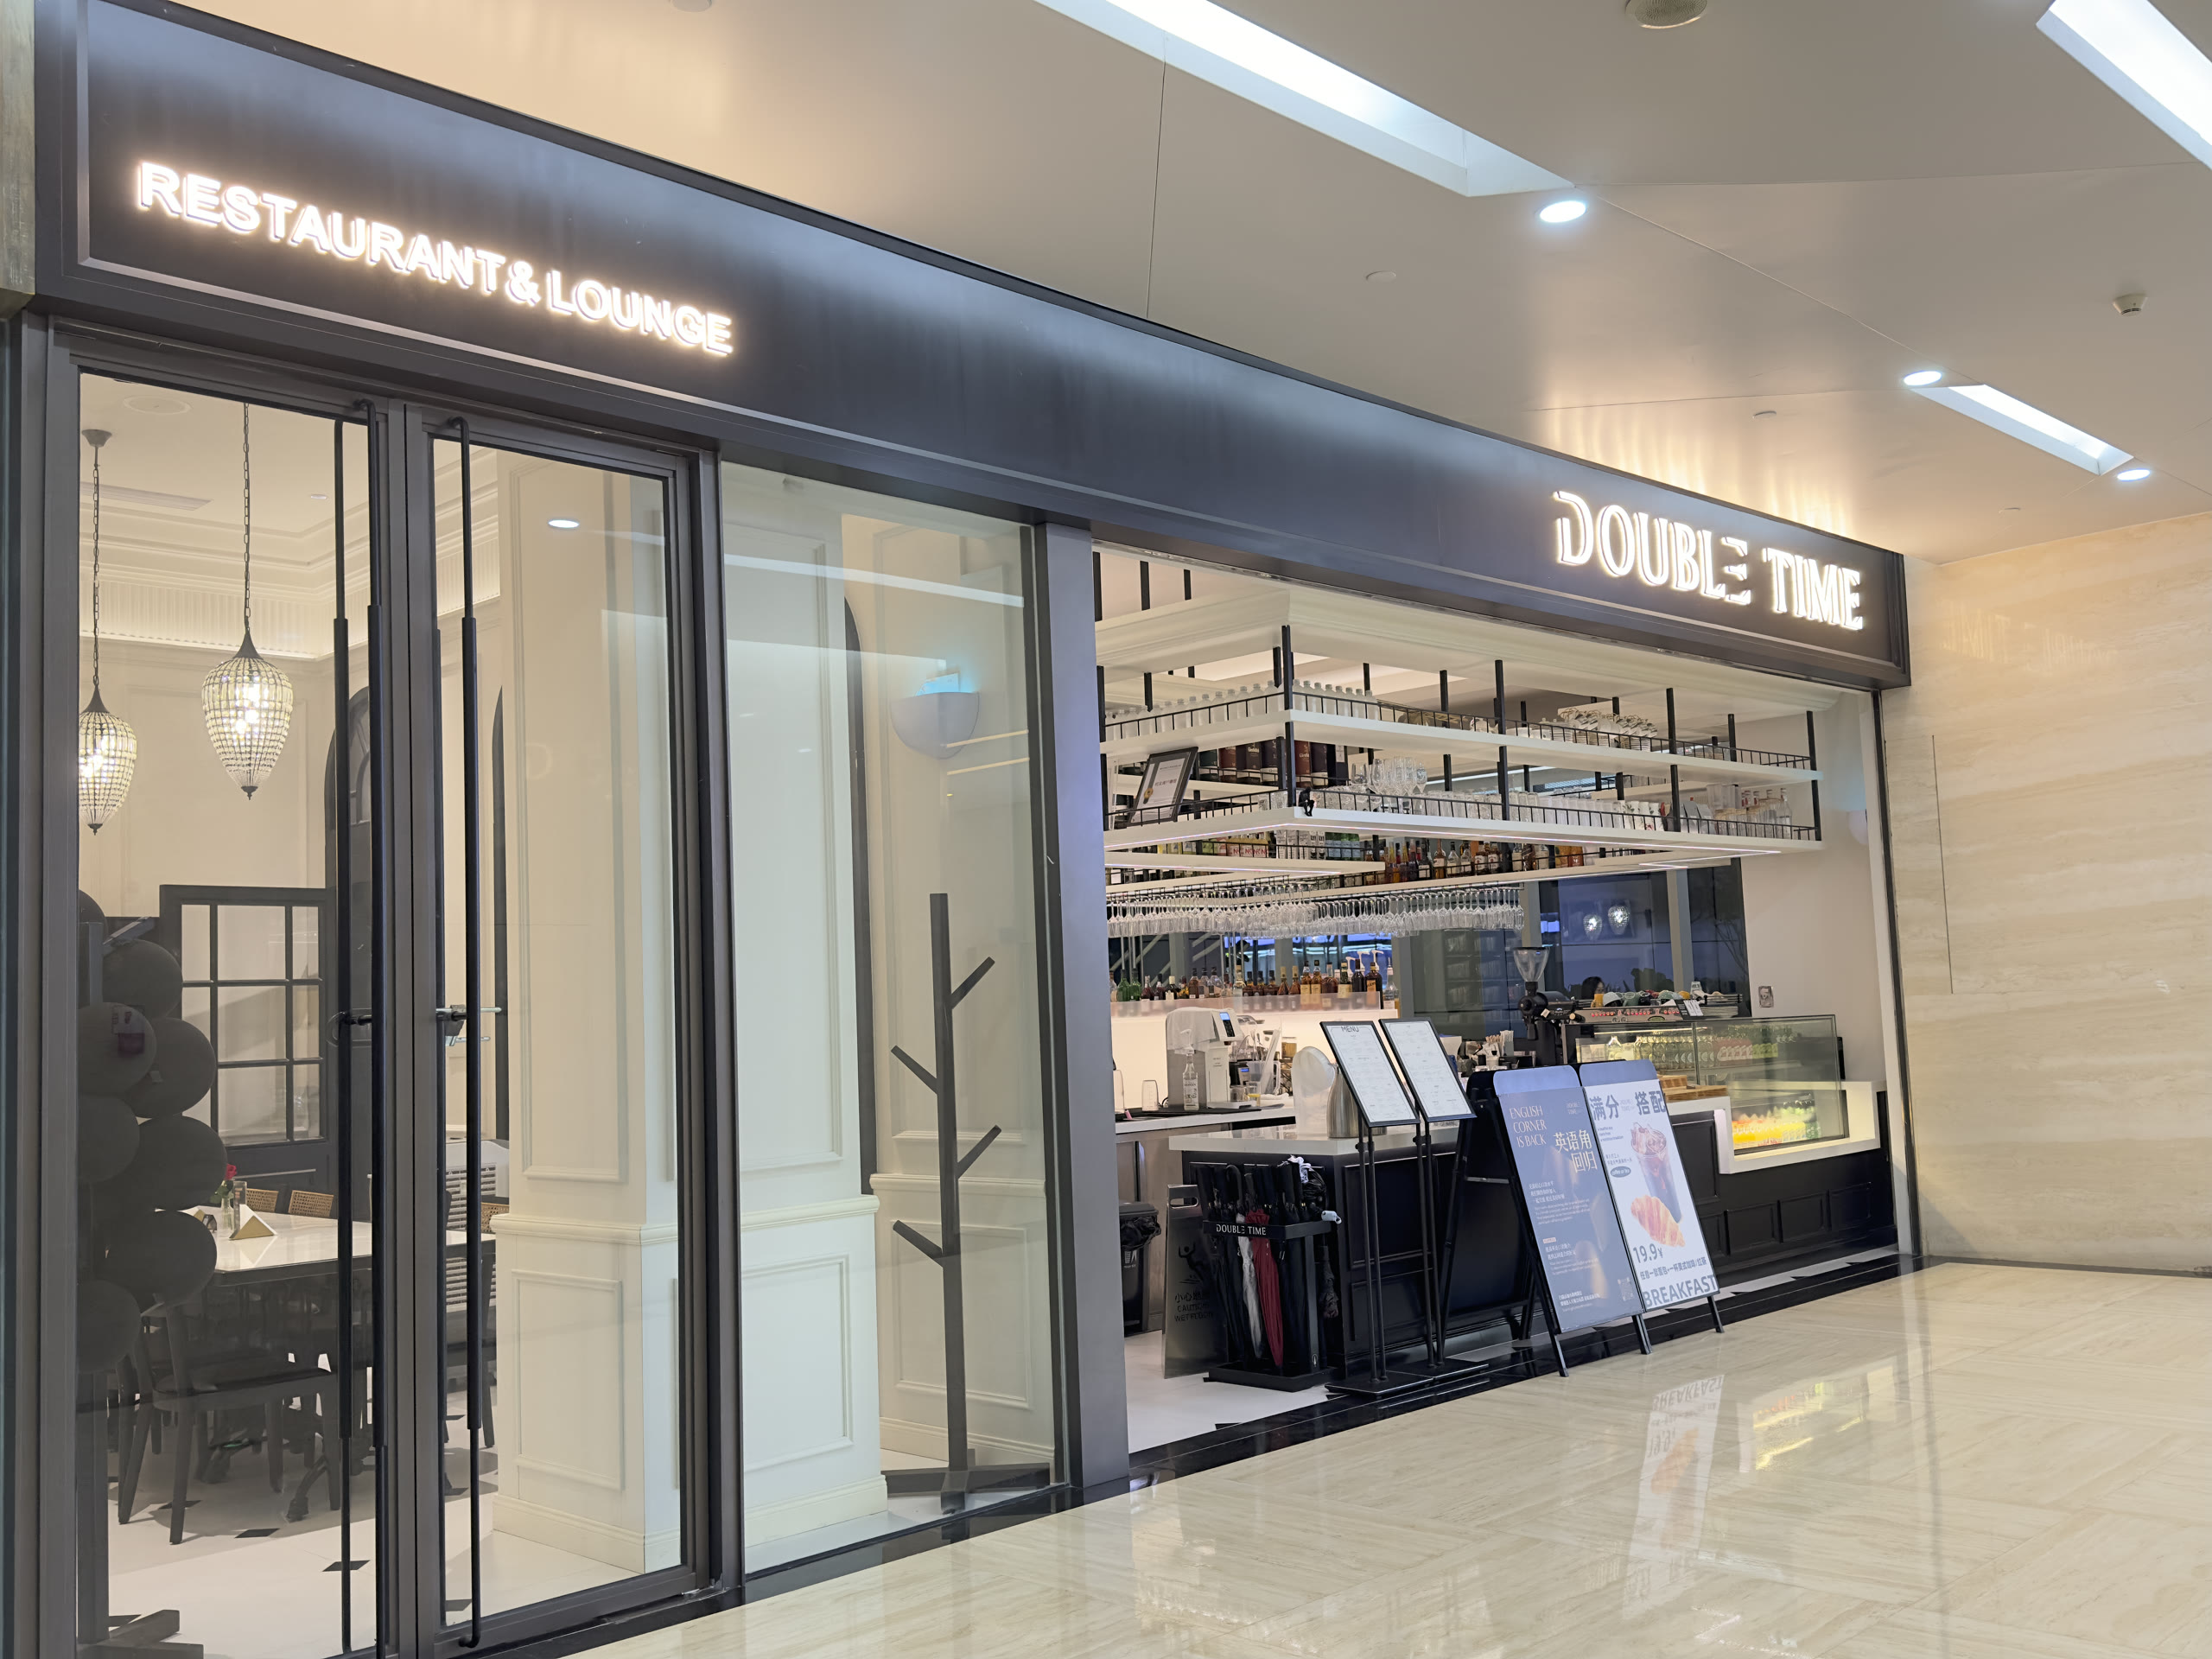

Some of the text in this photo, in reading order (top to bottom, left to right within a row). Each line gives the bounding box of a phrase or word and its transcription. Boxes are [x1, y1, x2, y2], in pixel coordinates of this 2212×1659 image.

[548, 267, 734, 356] LOUNGE
[1553, 490, 1863, 631] DOUBLE TIME
[1509, 1105, 1544, 1119] ENGLISH
[1590, 1090, 1667, 1121] 满分 搭配
[1513, 1119, 1547, 1134] CORNER
[1516, 1134, 1547, 1147] IS BACK
[1553, 1129, 1592, 1154] 英语角
[1571, 1150, 1598, 1173] 回归
[1216, 1224, 1267, 1236] DOUBLE TIME
[1643, 1274, 1716, 1308] BREAKFAST
[1174, 1313, 1189, 1322] WET
[1177, 1303, 1210, 1313] CAUTIO
